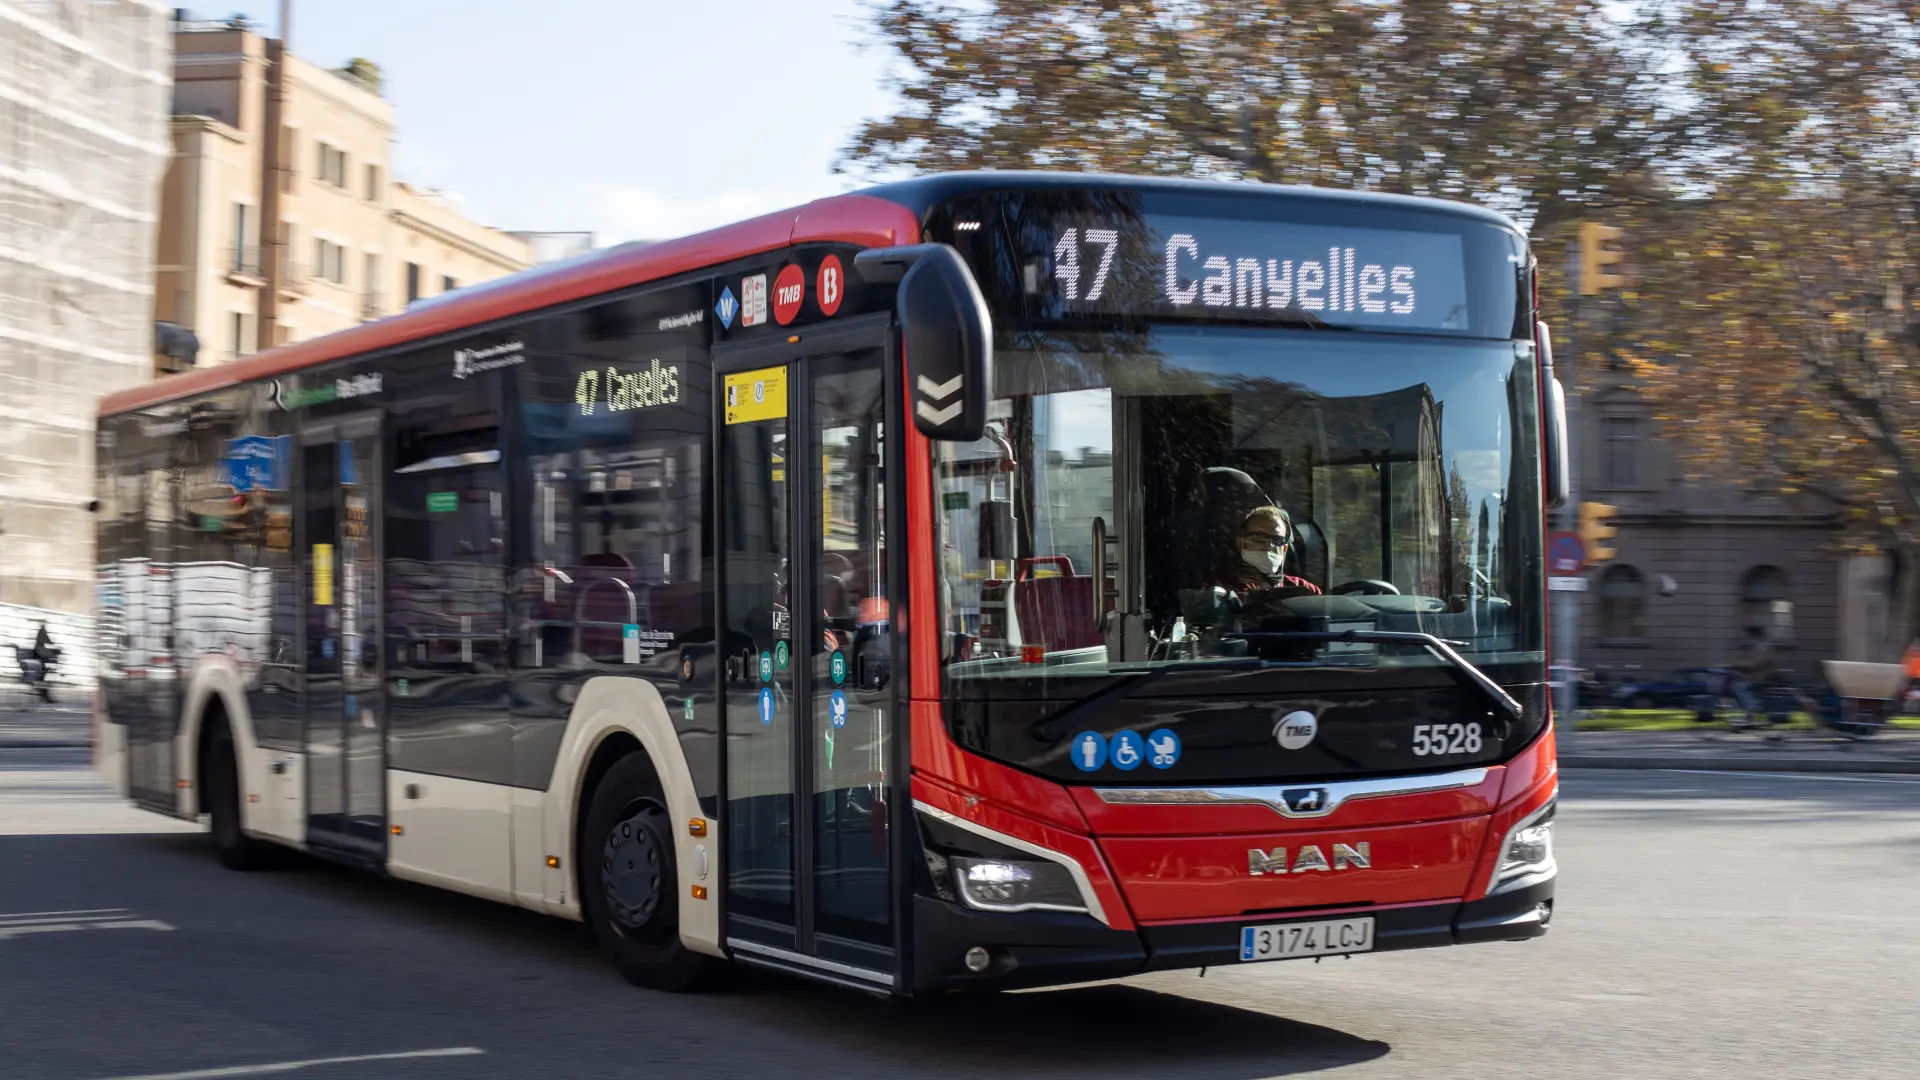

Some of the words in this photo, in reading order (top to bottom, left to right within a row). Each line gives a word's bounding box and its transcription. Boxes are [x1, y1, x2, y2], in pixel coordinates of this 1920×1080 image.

[1053, 227, 1118, 301] 47
[1165, 233, 1415, 314] Canyelles
[720, 297, 733, 318] W
[778, 283, 801, 306] TMB
[575, 369, 599, 416] 47
[1285, 725, 1313, 738] TMB
[1412, 722, 1482, 756] 5528
[1247, 841, 1372, 876] MAN
[1258, 925, 1318, 955] 3174
[1324, 922, 1368, 949] LCJ
